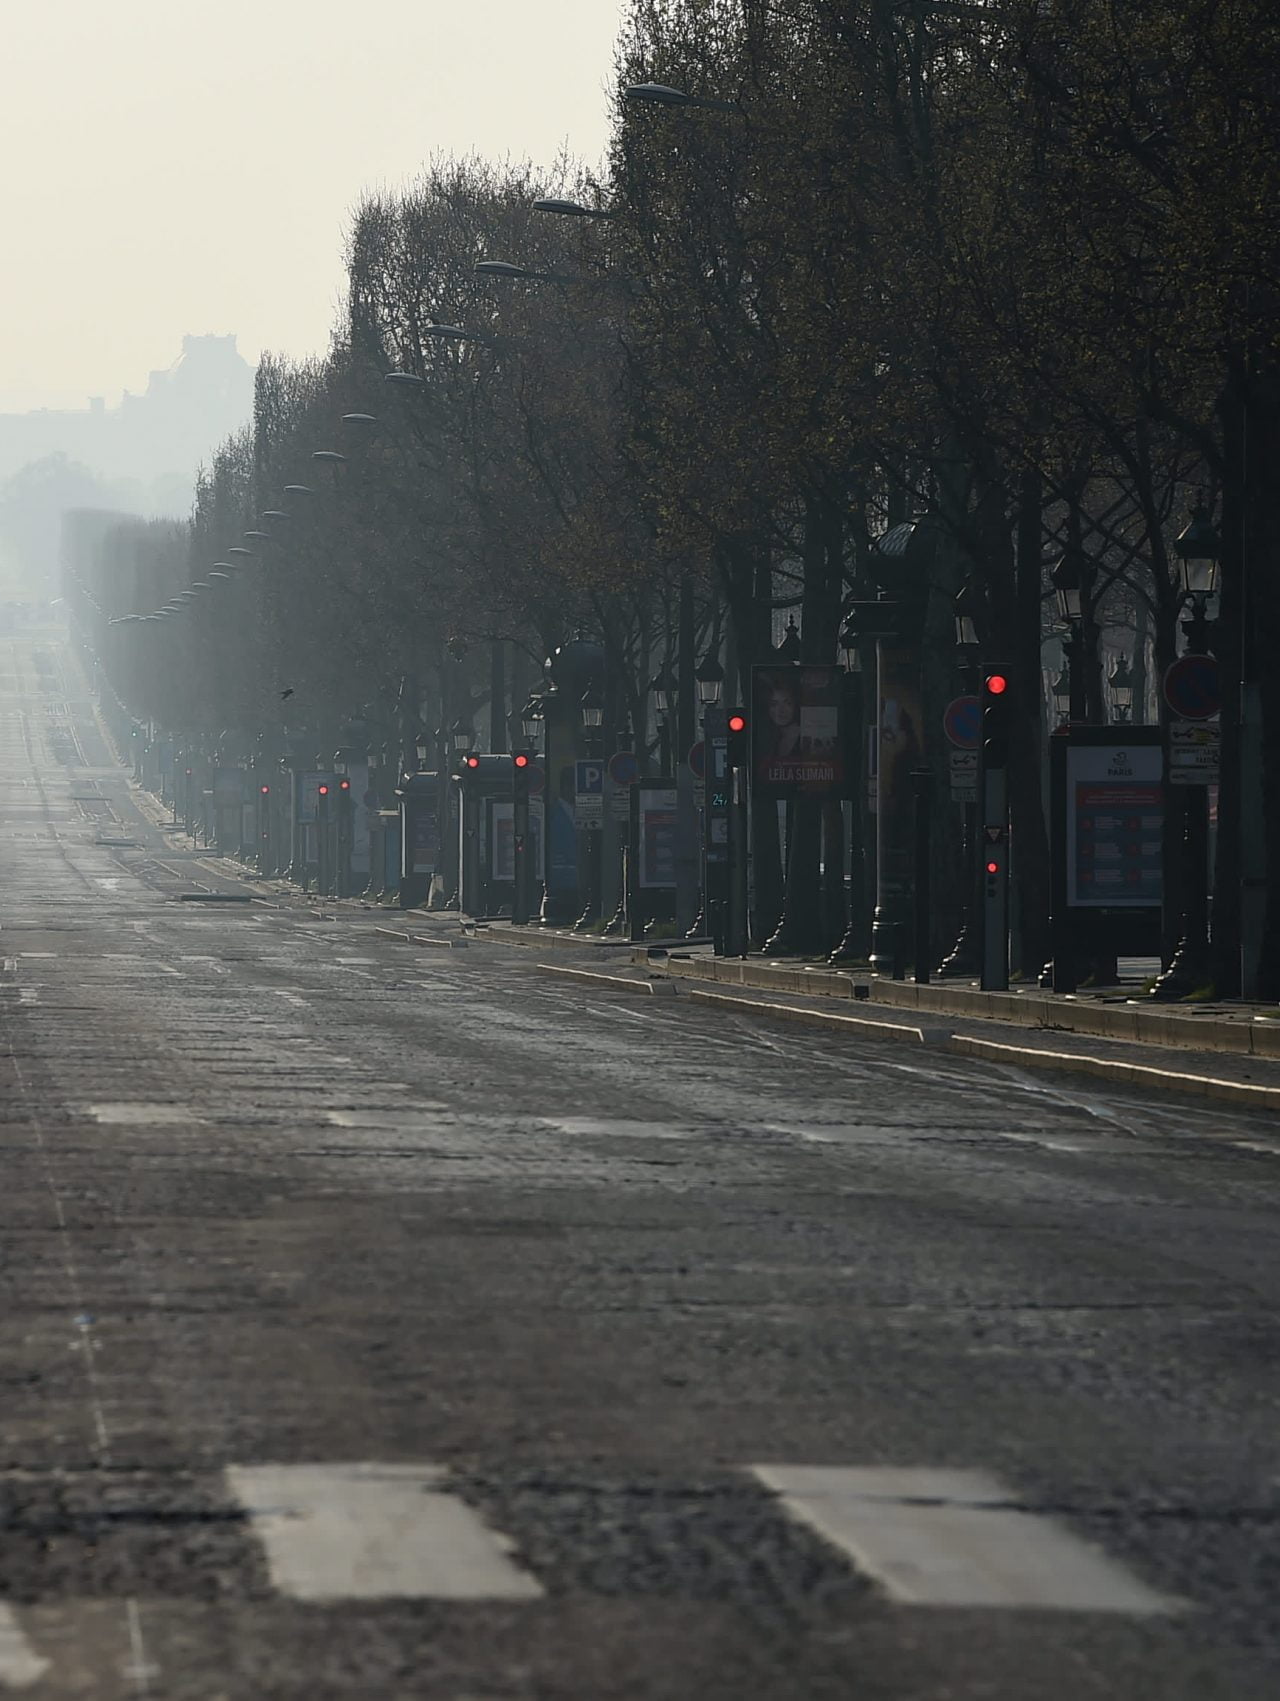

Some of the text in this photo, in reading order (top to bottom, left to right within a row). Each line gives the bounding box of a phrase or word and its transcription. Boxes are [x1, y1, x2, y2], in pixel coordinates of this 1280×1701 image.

[585, 767, 600, 788] P
[796, 767, 833, 781] SLIMANI
[1107, 769, 1133, 777] PARIS
